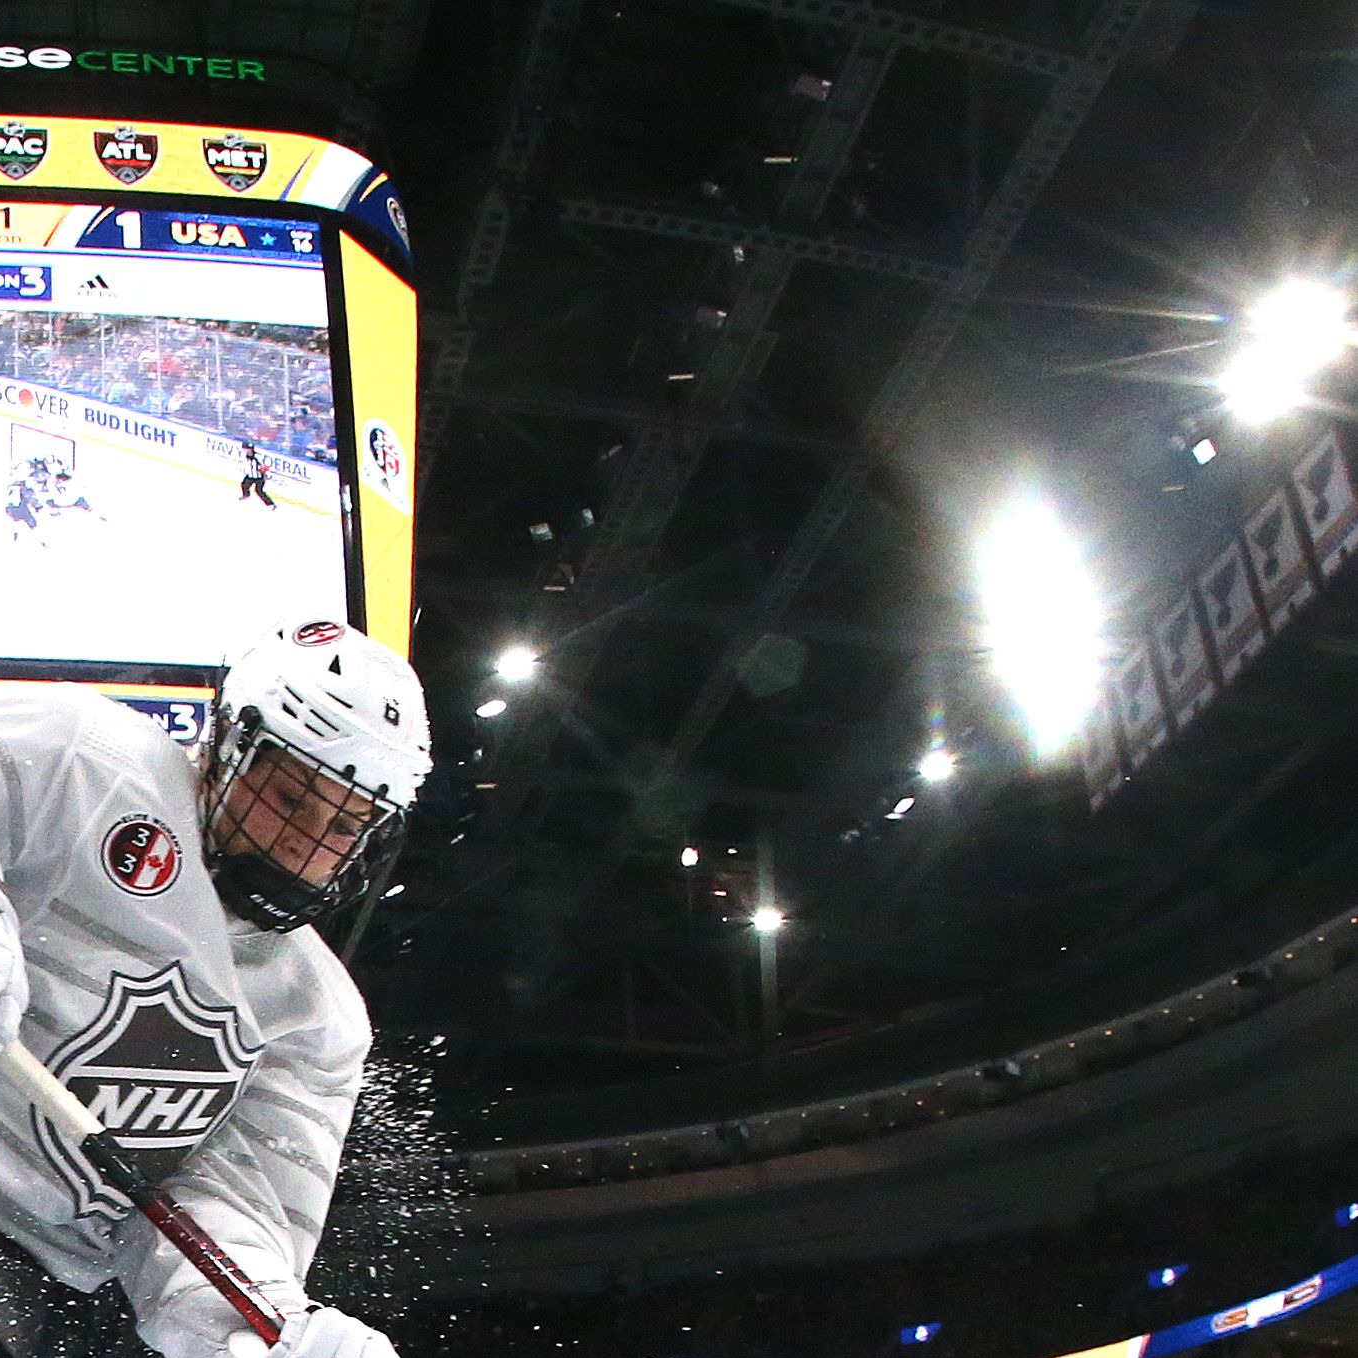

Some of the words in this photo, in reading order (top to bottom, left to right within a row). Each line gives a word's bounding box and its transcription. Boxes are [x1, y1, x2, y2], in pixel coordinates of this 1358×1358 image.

[76, 50, 266, 81] CENTER
[101, 140, 153, 161] ATL
[207, 148, 264, 169] MET
[115, 210, 141, 249] 1
[170, 220, 247, 248] USA
[20, 266, 46, 297] 3
[84, 406, 121, 431] BUD
[124, 418, 178, 448] LIGHT
[169, 703, 198, 740] 3
[131, 827, 151, 847] 3
[117, 853, 138, 874] 3
[86, 1084, 220, 1132] NHL
